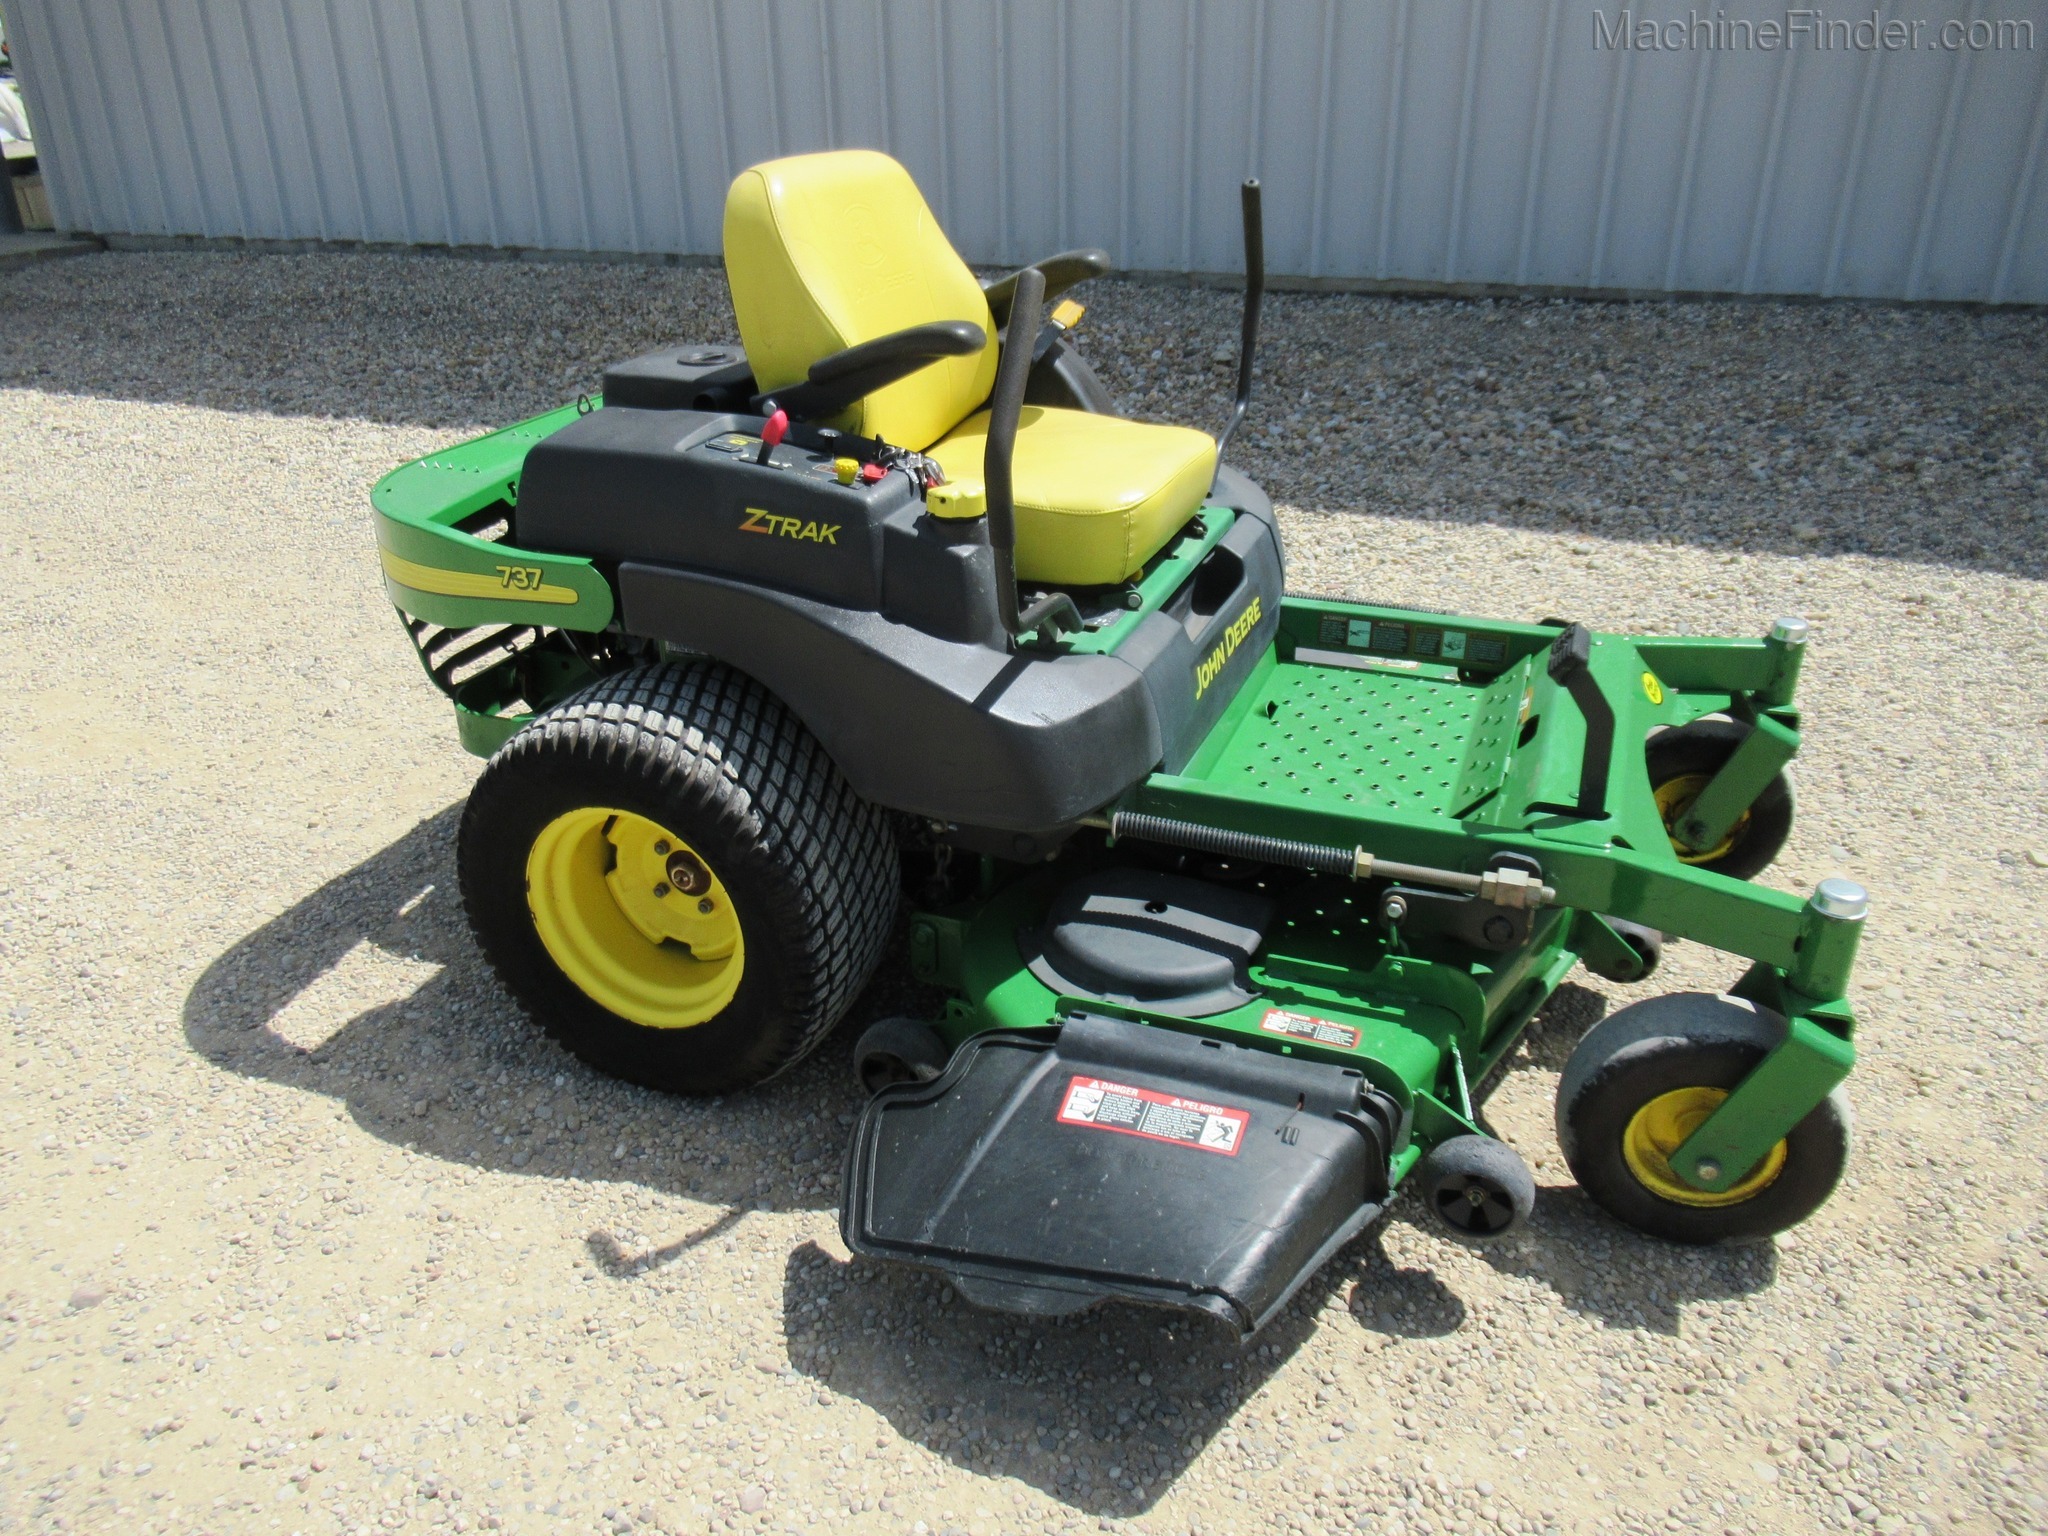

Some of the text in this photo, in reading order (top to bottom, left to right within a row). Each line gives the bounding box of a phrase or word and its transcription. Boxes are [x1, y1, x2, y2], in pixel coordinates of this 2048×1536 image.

[738, 507, 842, 545] ZTRAK
[496, 565, 543, 591] 737
[1196, 596, 1262, 700] JOHN DEERE
[1100, 1083, 1139, 1097] DANGER
[1182, 1100, 1224, 1116] PELIGRO
